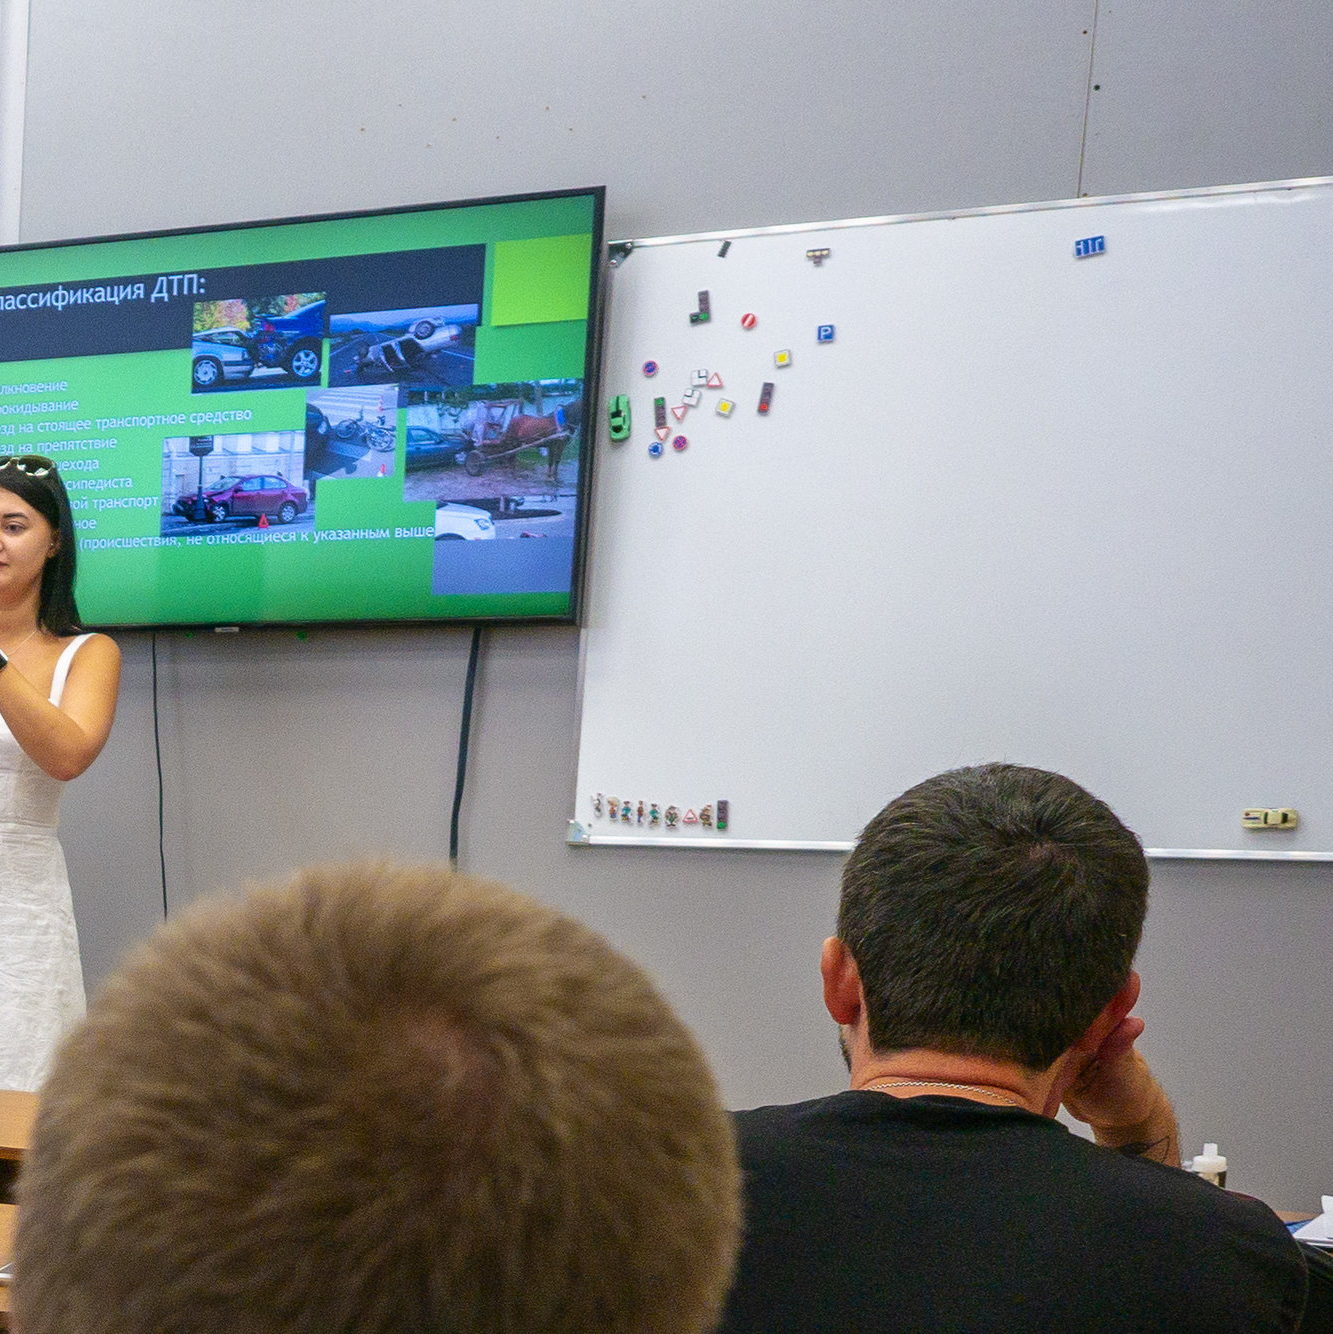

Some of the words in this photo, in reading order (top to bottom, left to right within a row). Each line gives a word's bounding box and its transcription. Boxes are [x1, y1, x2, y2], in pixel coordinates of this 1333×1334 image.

[150, 273, 207, 303] ДТП:
[18, 421, 34, 434] на
[37, 417, 92, 434] стоящее
[97, 411, 186, 431] транспортное
[189, 408, 253, 425] средство
[18, 441, 34, 454] на
[37, 436, 118, 456] препятствие
[58, 458, 100, 471] ехода
[65, 477, 133, 491] сипедиста
[93, 495, 159, 513] транспорт
[79, 535, 182, 552] (происшествия,
[186, 534, 203, 545] не
[206, 530, 297, 546] относящиеся
[300, 532, 310, 542] к
[313, 527, 390, 545] указанным
